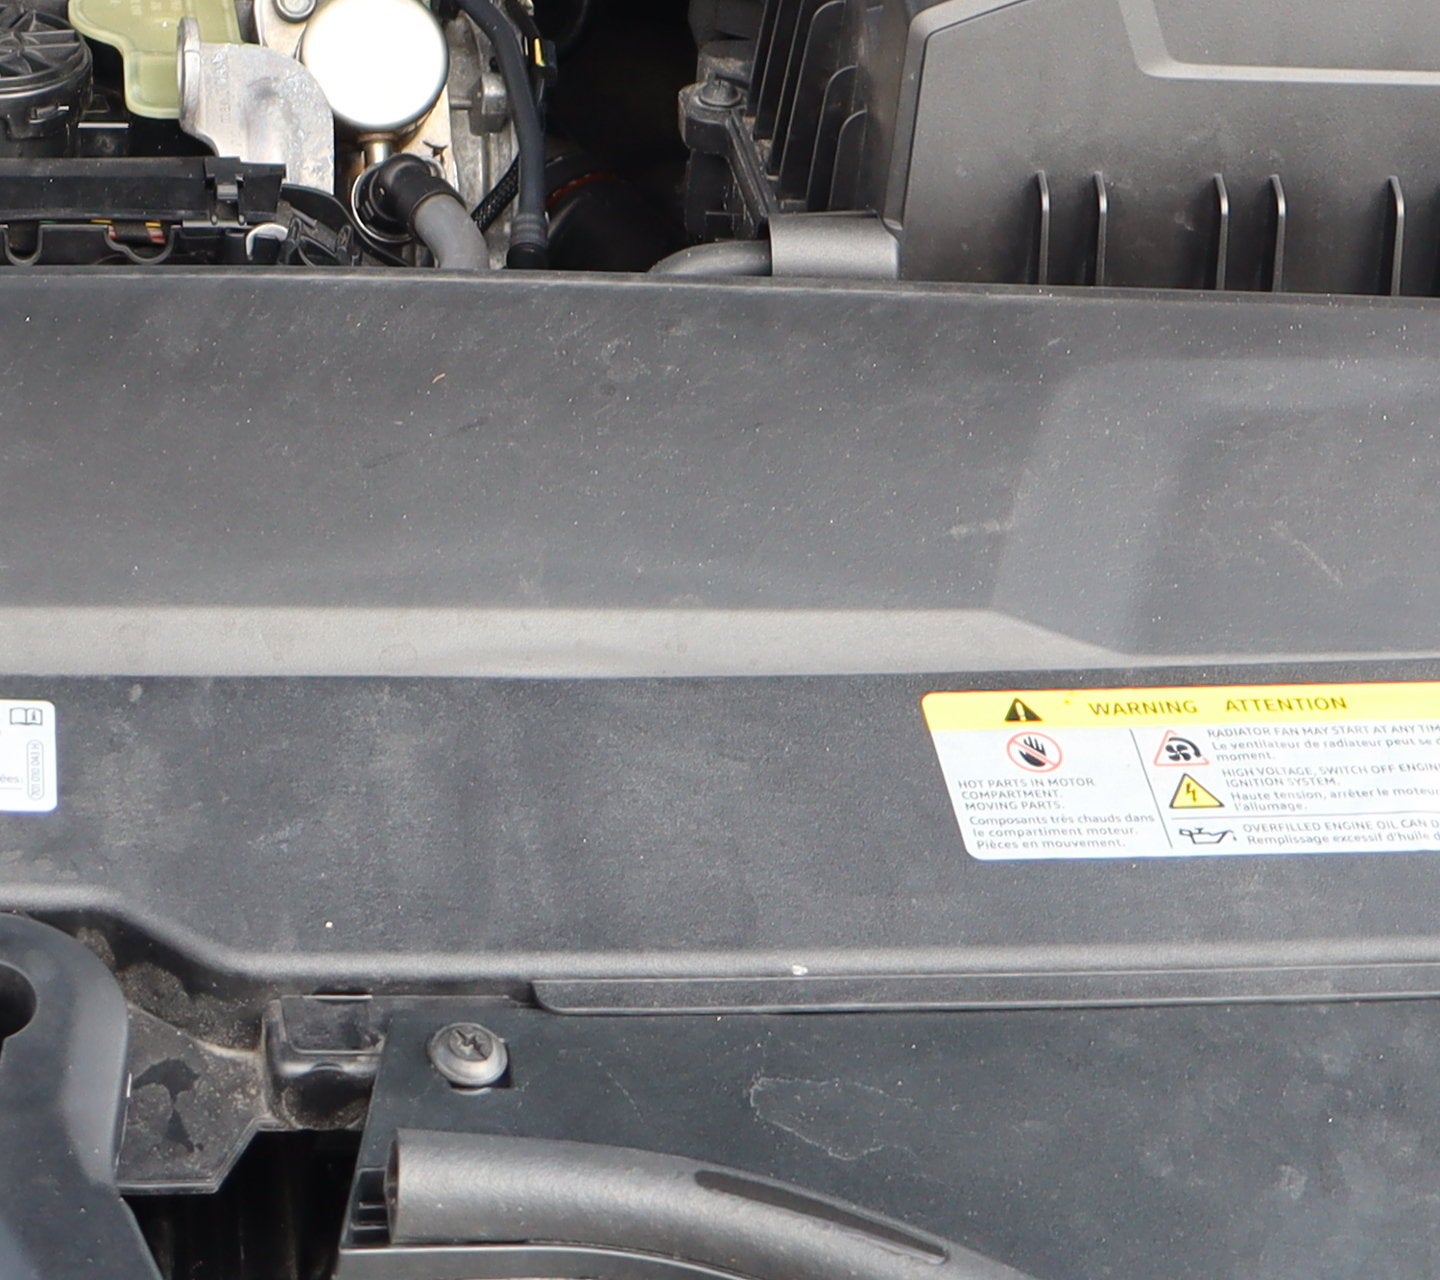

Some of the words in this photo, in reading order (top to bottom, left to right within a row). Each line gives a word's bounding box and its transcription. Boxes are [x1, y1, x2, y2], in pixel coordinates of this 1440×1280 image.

[1088, 700, 1197, 716] WARNING
[1225, 696, 1347, 713] ATTENTION
[1207, 728, 1270, 737] RADIATOR
[1274, 727, 1299, 736] FAN
[1302, 726, 1328, 735] MAY
[1333, 726, 1370, 734] START
[1373, 726, 1388, 734] AT
[1391, 725, 1415, 733] ANY
[1213, 742, 1227, 750] Le
[1231, 740, 1300, 749] ventilateur
[1304, 739, 1319, 748] de
[1323, 738, 1381, 747] radiateur
[1386, 738, 1414, 748] peut
[1222, 768, 1254, 777] HIGH
[1321, 766, 1367, 775] SWITCH
[1371, 765, 1395, 773] OFF
[958, 780, 983, 789] HOT
[988, 779, 1026, 788] PARTS
[1031, 778, 1044, 787] IN
[1048, 777, 1095, 787] MOTOR
[1226, 778, 1284, 787] IGNITION
[1231, 791, 1270, 801] Haute
[1393, 787, 1440, 796] moteur
[966, 801, 1017, 811] MOVING
[970, 816, 1047, 827] Composants
[1078, 815, 1121, 824] chauds
[1125, 813, 1155, 823] dans
[1243, 822, 1320, 833] OVERFILLED
[1325, 821, 1372, 831] ENGINE
[1376, 820, 1397, 829] OIL
[1401, 819, 1427, 828] CAN
[973, 828, 984, 837] le
[989, 827, 1082, 838] compartiment
[1248, 834, 1328, 845] Remplissage
[1333, 832, 1383, 842] excessif
[1022, 841, 1038, 849] en
